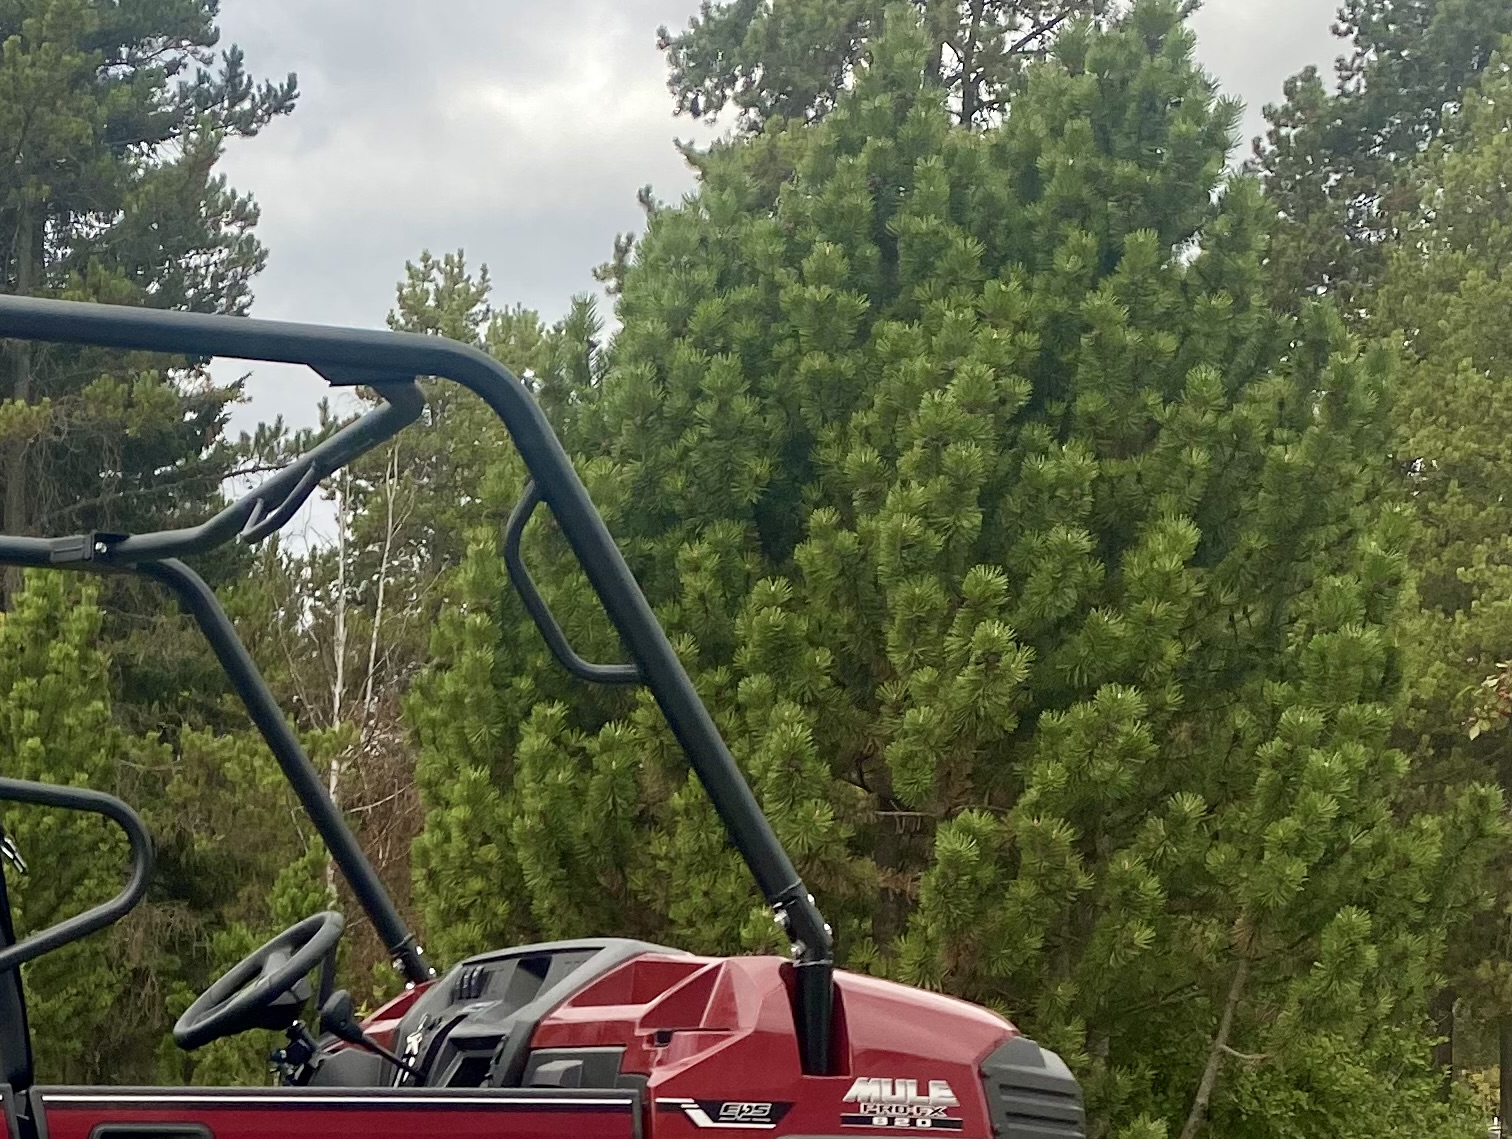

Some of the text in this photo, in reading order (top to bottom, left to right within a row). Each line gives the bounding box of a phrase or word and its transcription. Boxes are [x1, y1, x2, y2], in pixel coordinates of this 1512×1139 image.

[842, 1077, 961, 1107] MULE
[719, 1102, 773, 1120] EPS
[872, 1116, 932, 1128] 820
